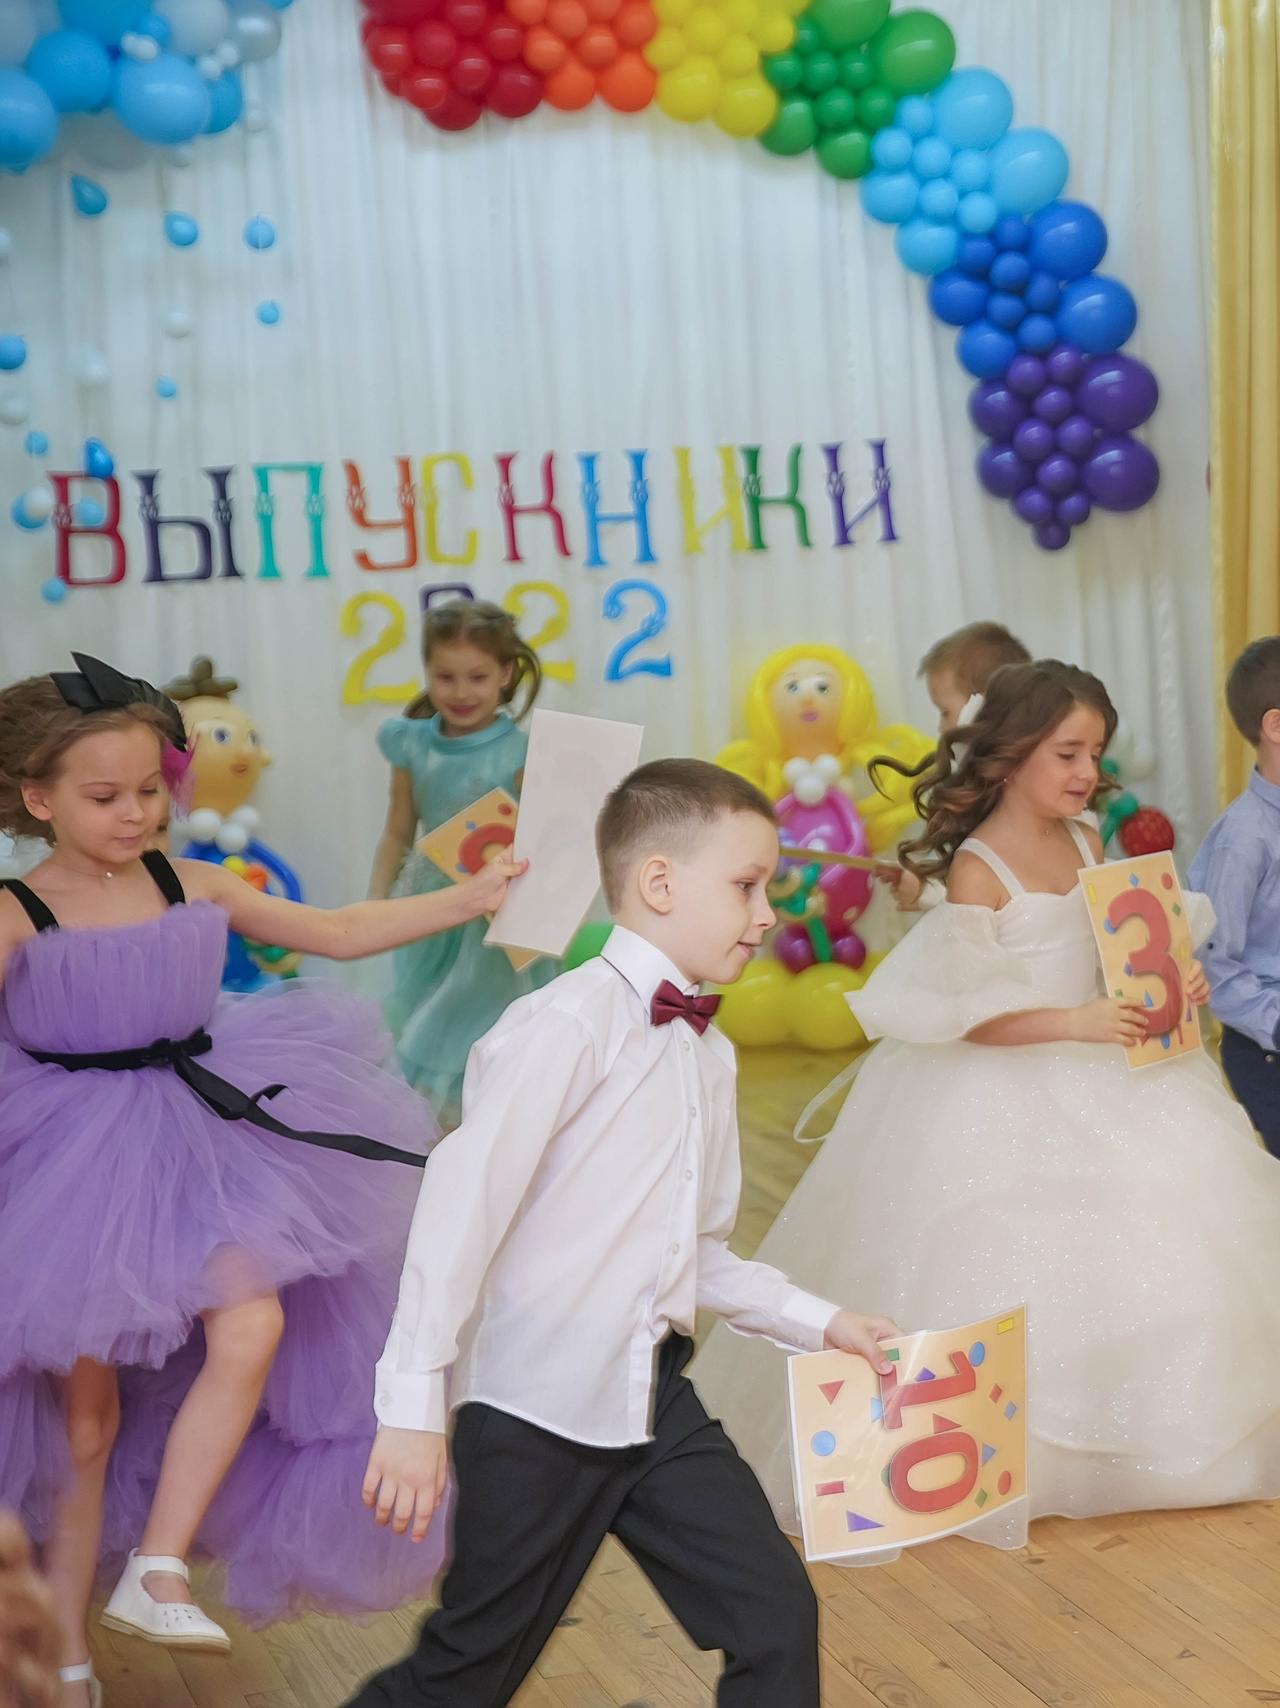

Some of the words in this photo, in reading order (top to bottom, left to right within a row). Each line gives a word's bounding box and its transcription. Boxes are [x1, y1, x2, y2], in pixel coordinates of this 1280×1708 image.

[46, 438, 900, 587] ВЫПУСКНИКИ
[340, 578, 673, 704] 222
[1107, 887, 1183, 1034] 3
[880, 1350, 978, 1514] 10
